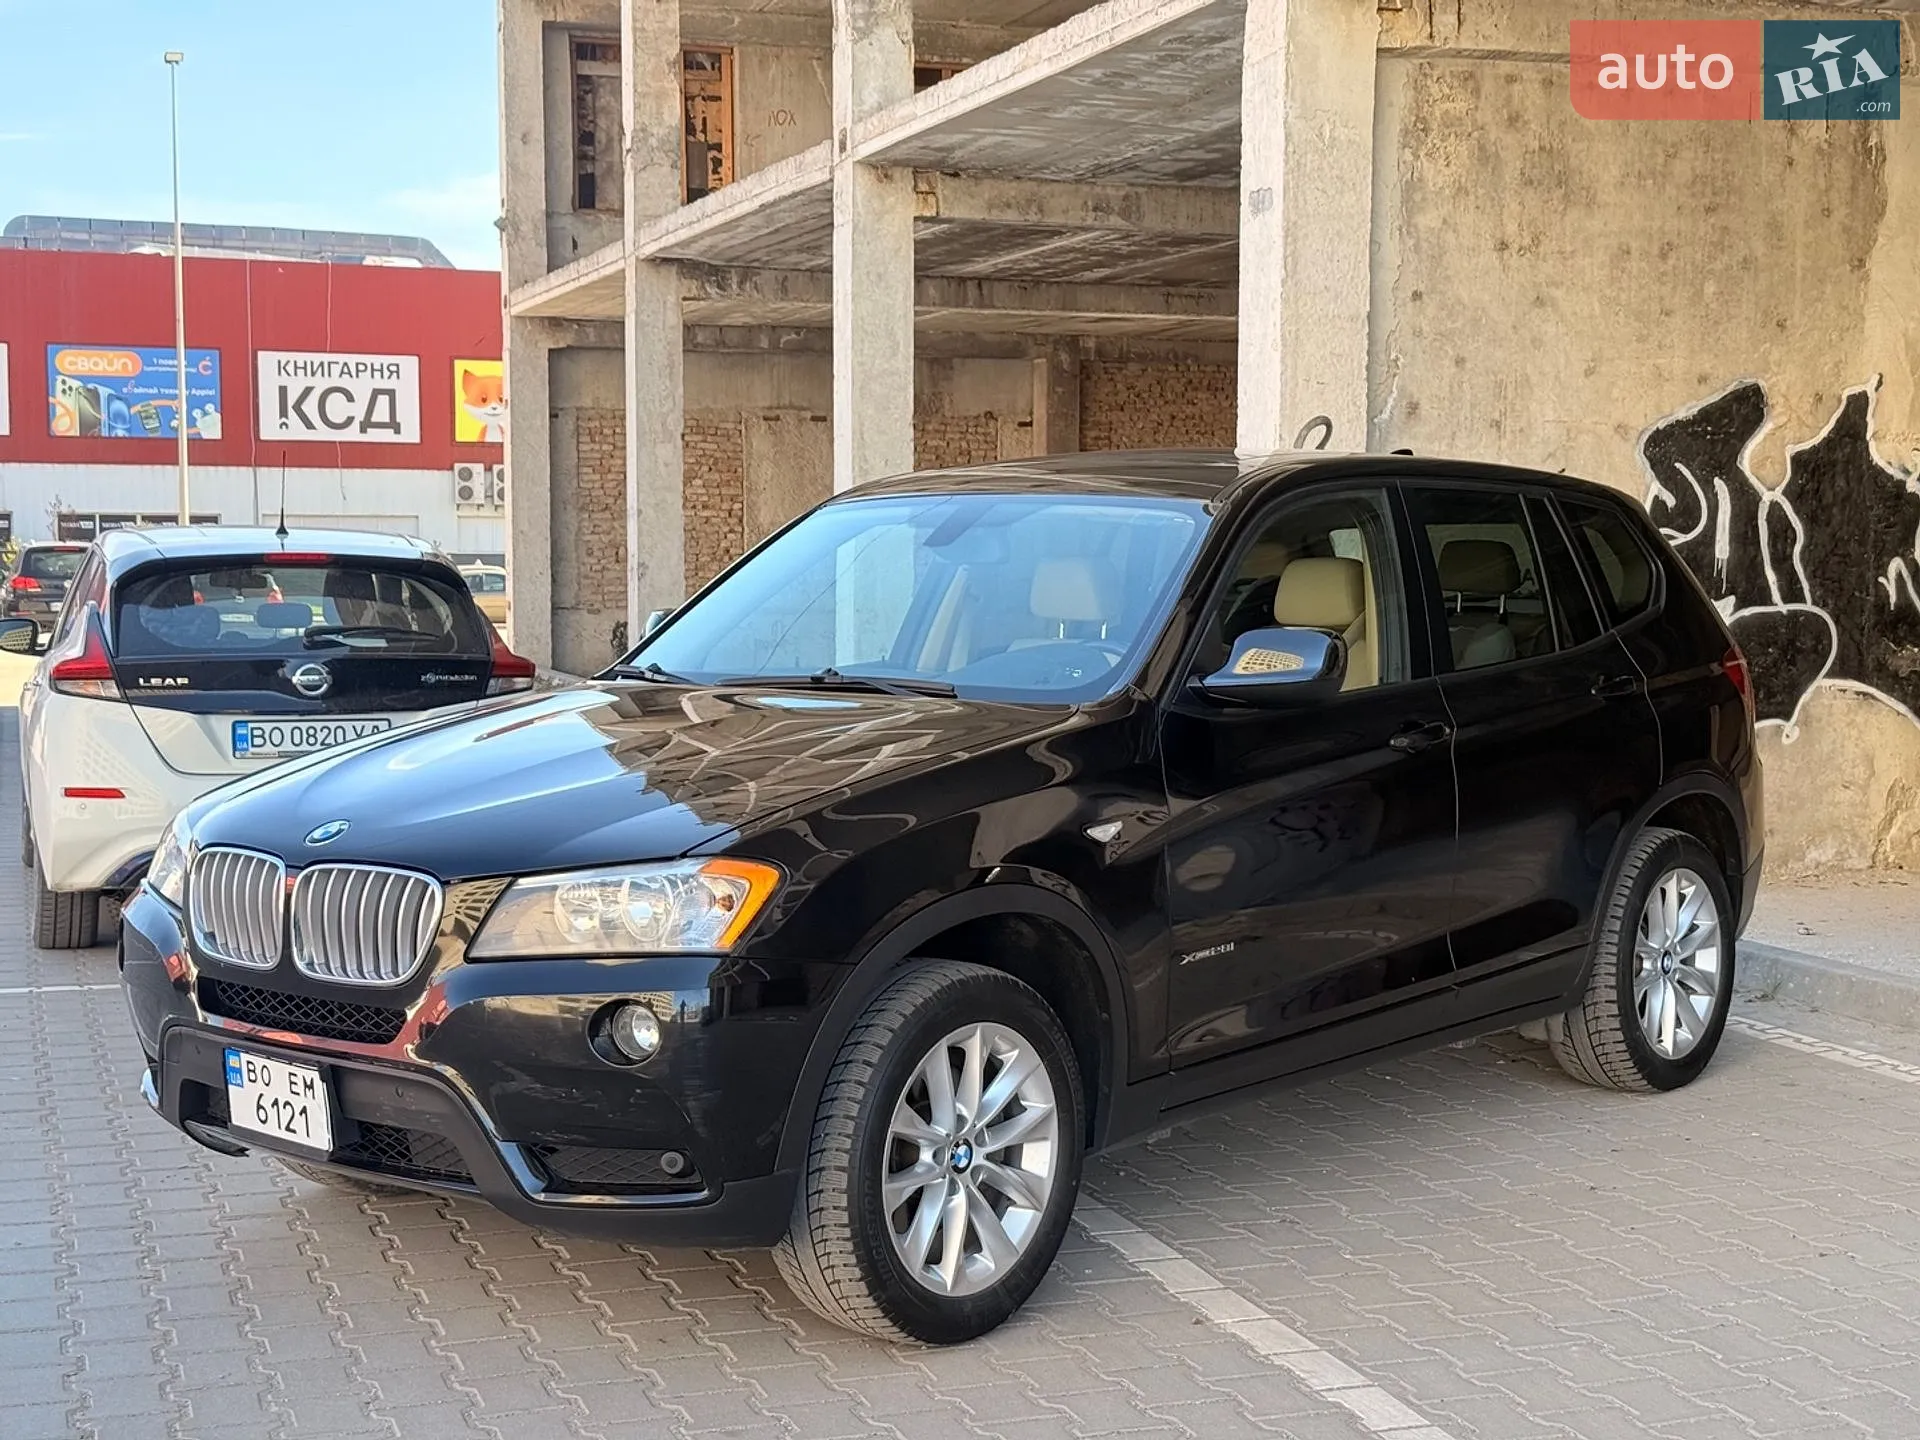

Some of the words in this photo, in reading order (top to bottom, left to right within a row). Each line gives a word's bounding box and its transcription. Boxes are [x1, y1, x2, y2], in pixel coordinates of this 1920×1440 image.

[277, 359, 401, 380] КНИГАРНЯ
[278, 385, 401, 435] КСД
[236, 741, 248, 749] UA
[250, 726, 285, 748] BO
[290, 725, 347, 748] 0820
[229, 1072, 241, 1085] UA
[246, 1060, 272, 1087] BO
[288, 1071, 316, 1100] EM
[256, 1093, 311, 1138] 6121
